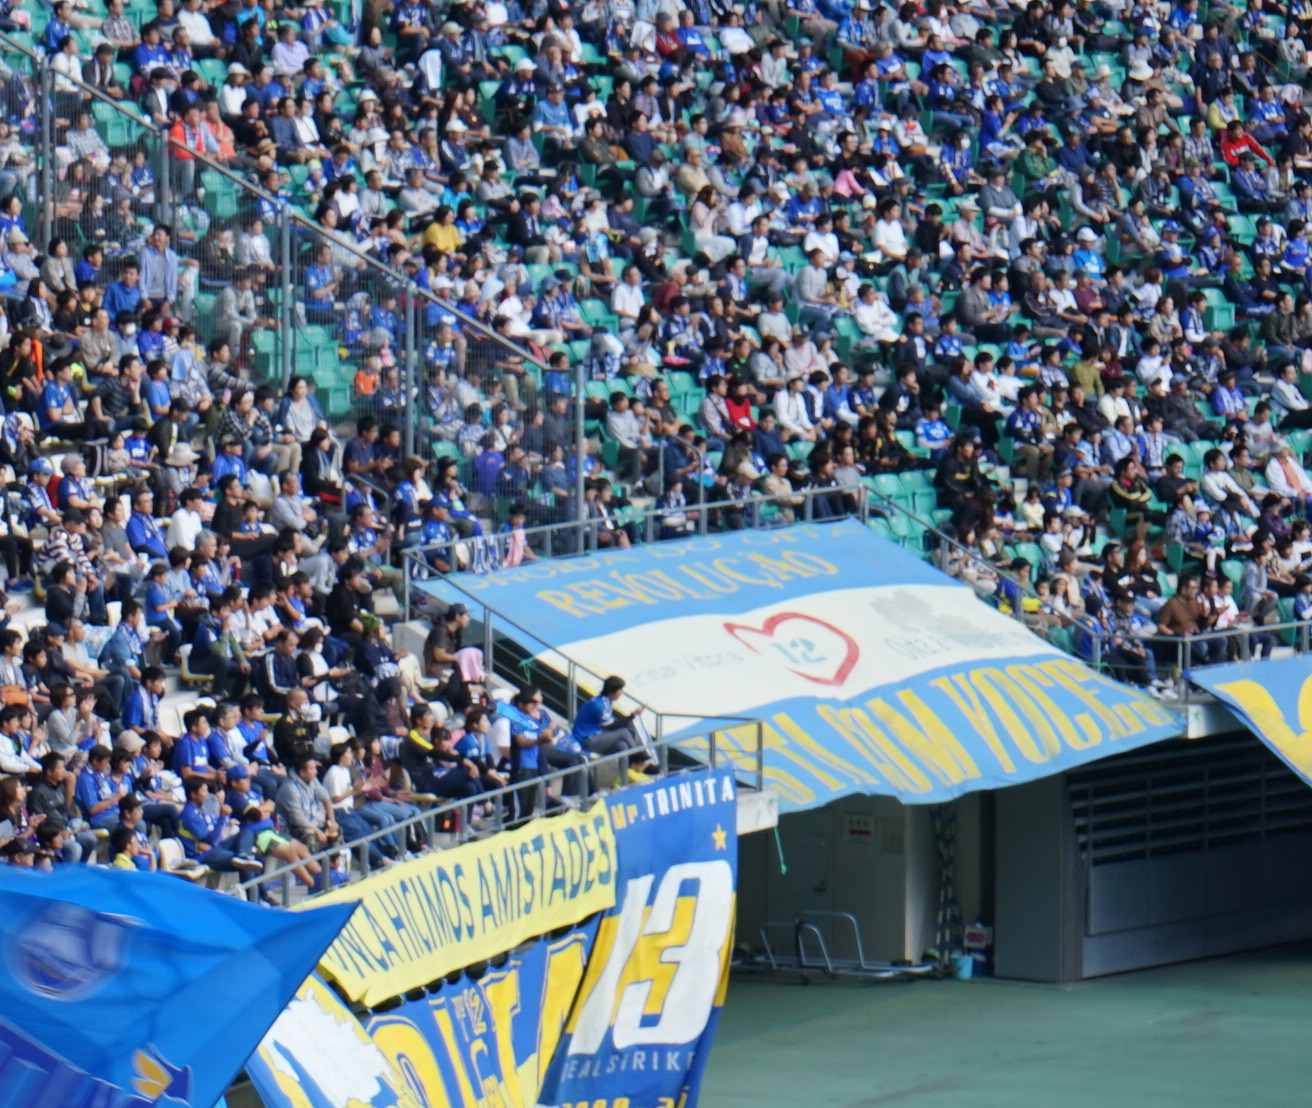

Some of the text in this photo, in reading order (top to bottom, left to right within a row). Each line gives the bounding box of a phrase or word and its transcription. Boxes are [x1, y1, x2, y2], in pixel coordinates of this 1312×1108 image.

[770, 636, 827, 667] 12
[643, 775, 735, 819] TRINITA
[383, 862, 475, 962] HICIMOS
[476, 813, 612, 934] AMISTADES
[566, 858, 734, 1056] 13
